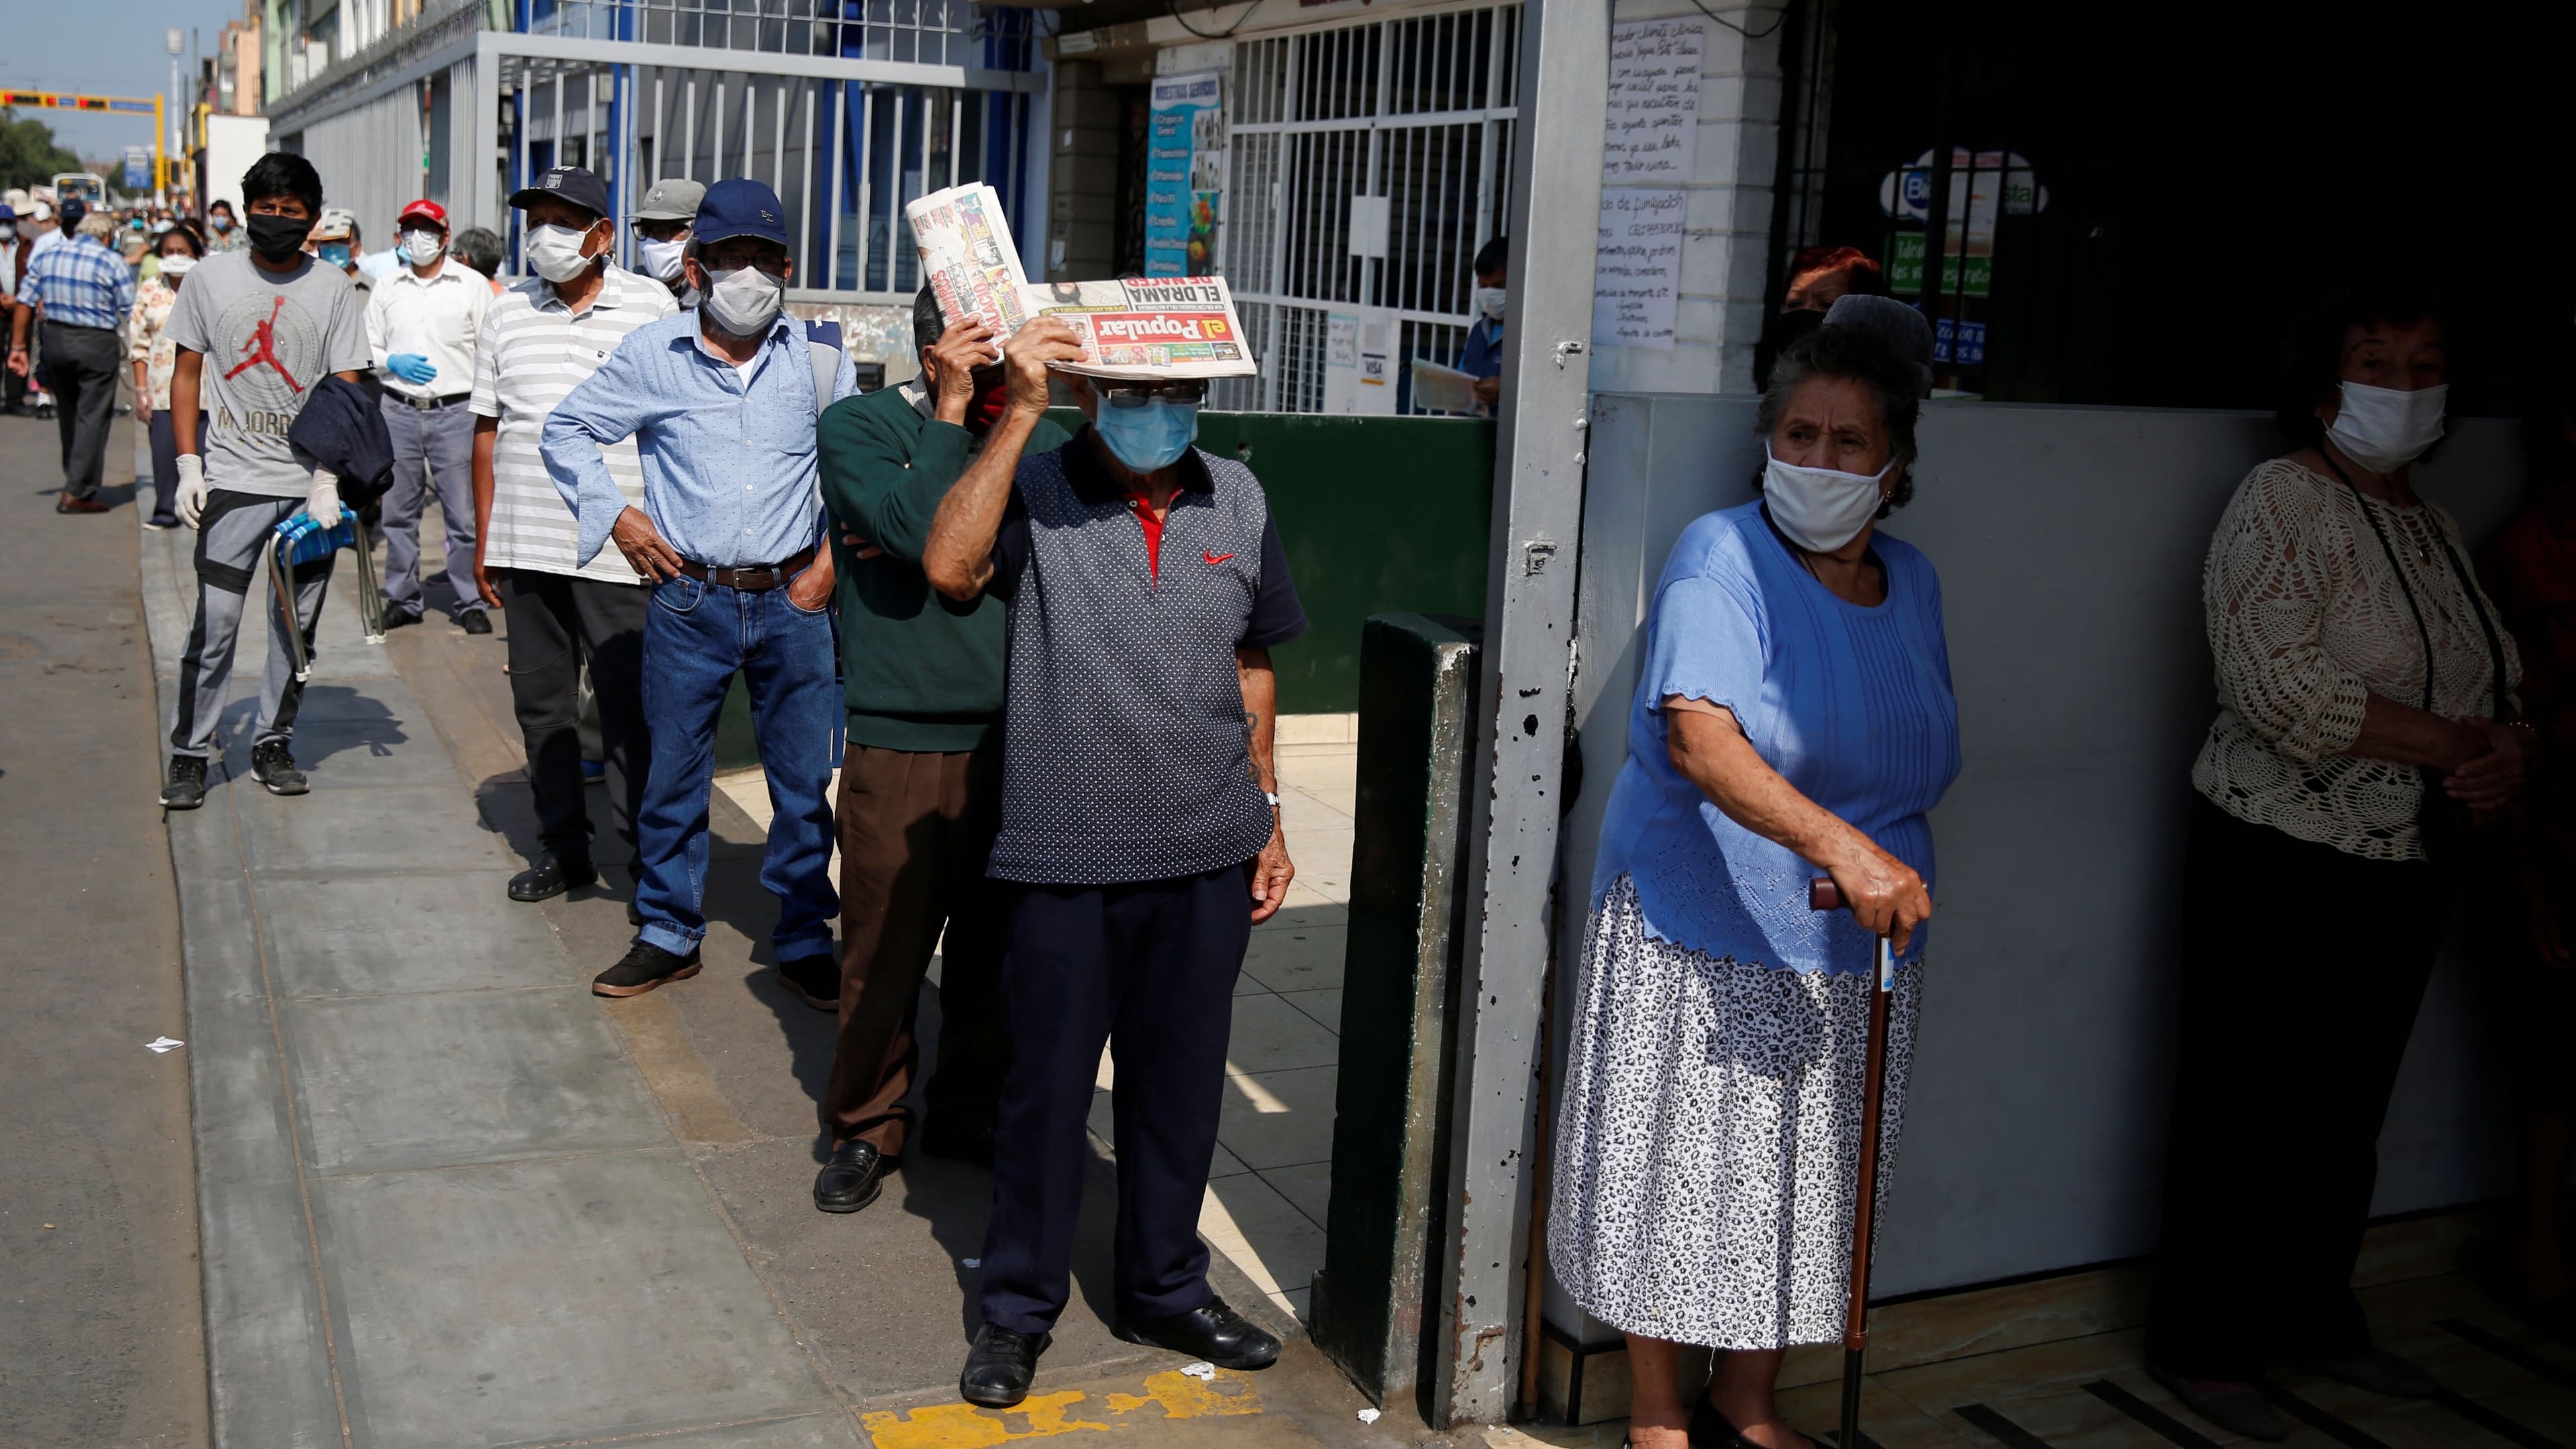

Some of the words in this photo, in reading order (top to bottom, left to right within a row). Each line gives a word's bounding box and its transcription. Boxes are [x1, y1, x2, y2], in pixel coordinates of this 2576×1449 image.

[1156, 84, 1187, 101] NUESTROS
[931, 270, 964, 323] NAVIRUS
[1129, 287, 1195, 303] DRAMA
[1196, 286, 1221, 302] EL
[1099, 315, 1202, 340] Popular
[1201, 318, 1228, 339] el
[1364, 360, 1383, 375] VISA
[243, 409, 292, 435] JORD
